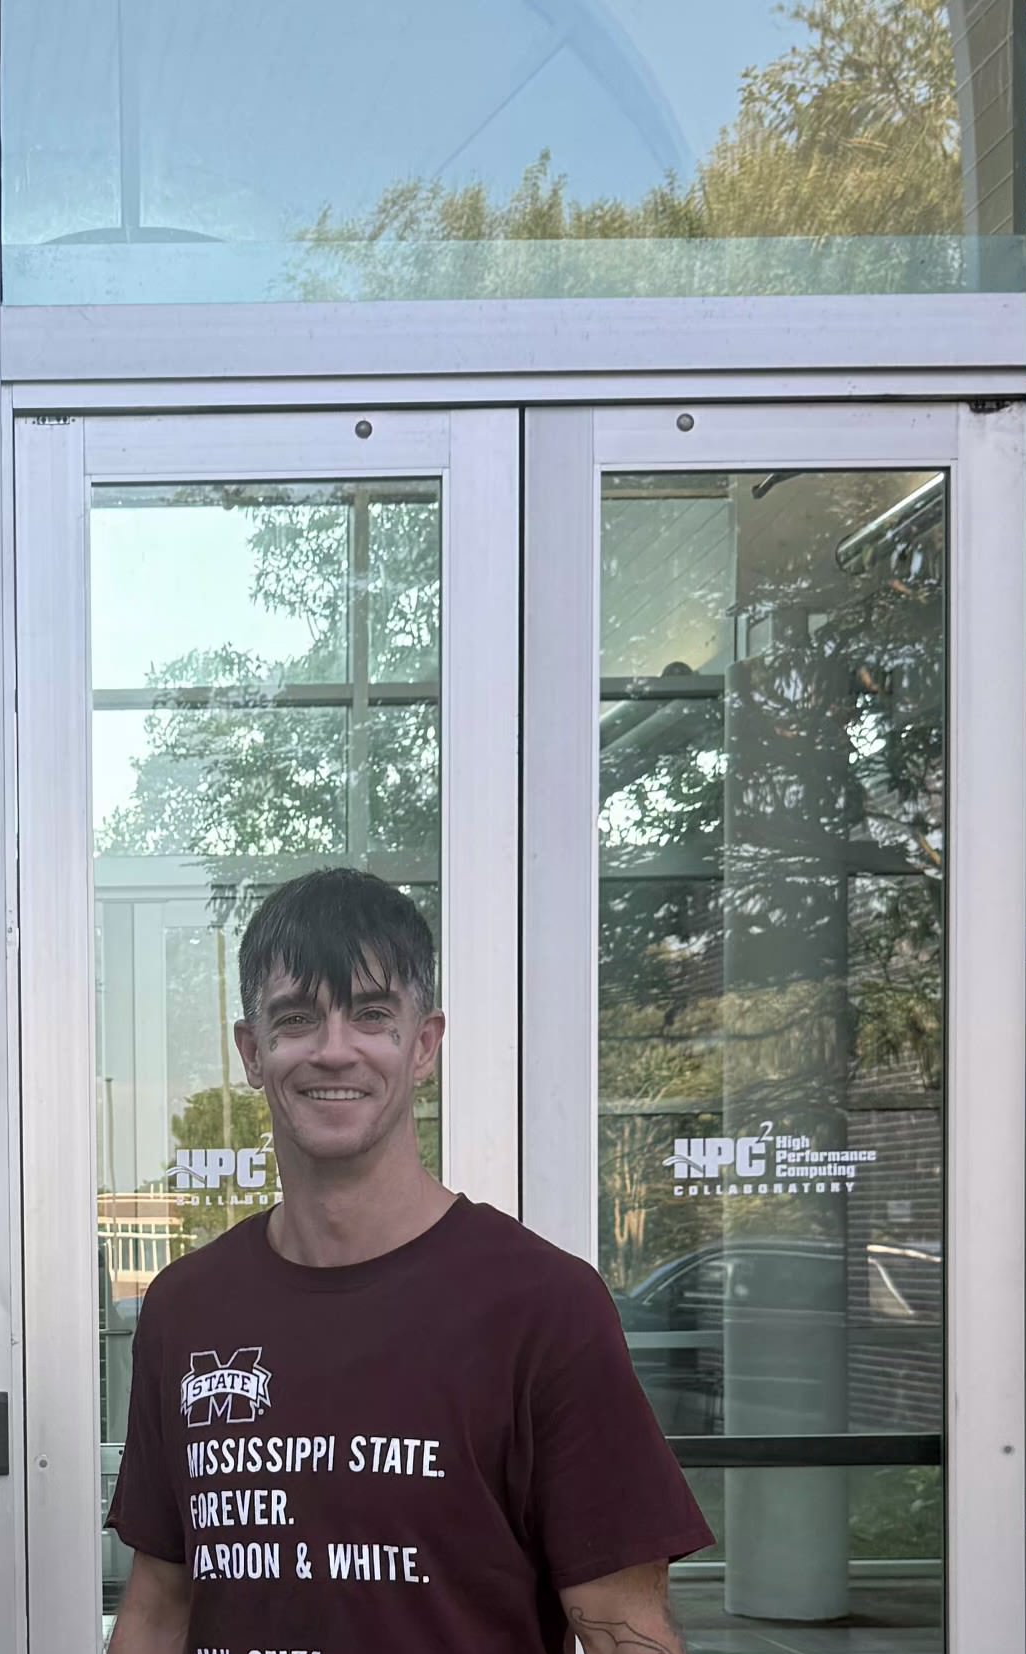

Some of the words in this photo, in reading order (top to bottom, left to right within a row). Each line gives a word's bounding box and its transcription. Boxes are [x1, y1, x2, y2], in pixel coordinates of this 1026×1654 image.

[775, 1135, 810, 1150] High
[775, 1149, 877, 1164] Performance
[775, 1163, 856, 1179] Computing
[674, 1181, 856, 1196] COLLABORATORY
[192, 1372, 252, 1398] STATE
[348, 1435, 446, 1478] STATE.
[190, 1489, 295, 1530] FOREVER.
[295, 1542, 313, 1580] &
[327, 1543, 430, 1584] WHITE.
